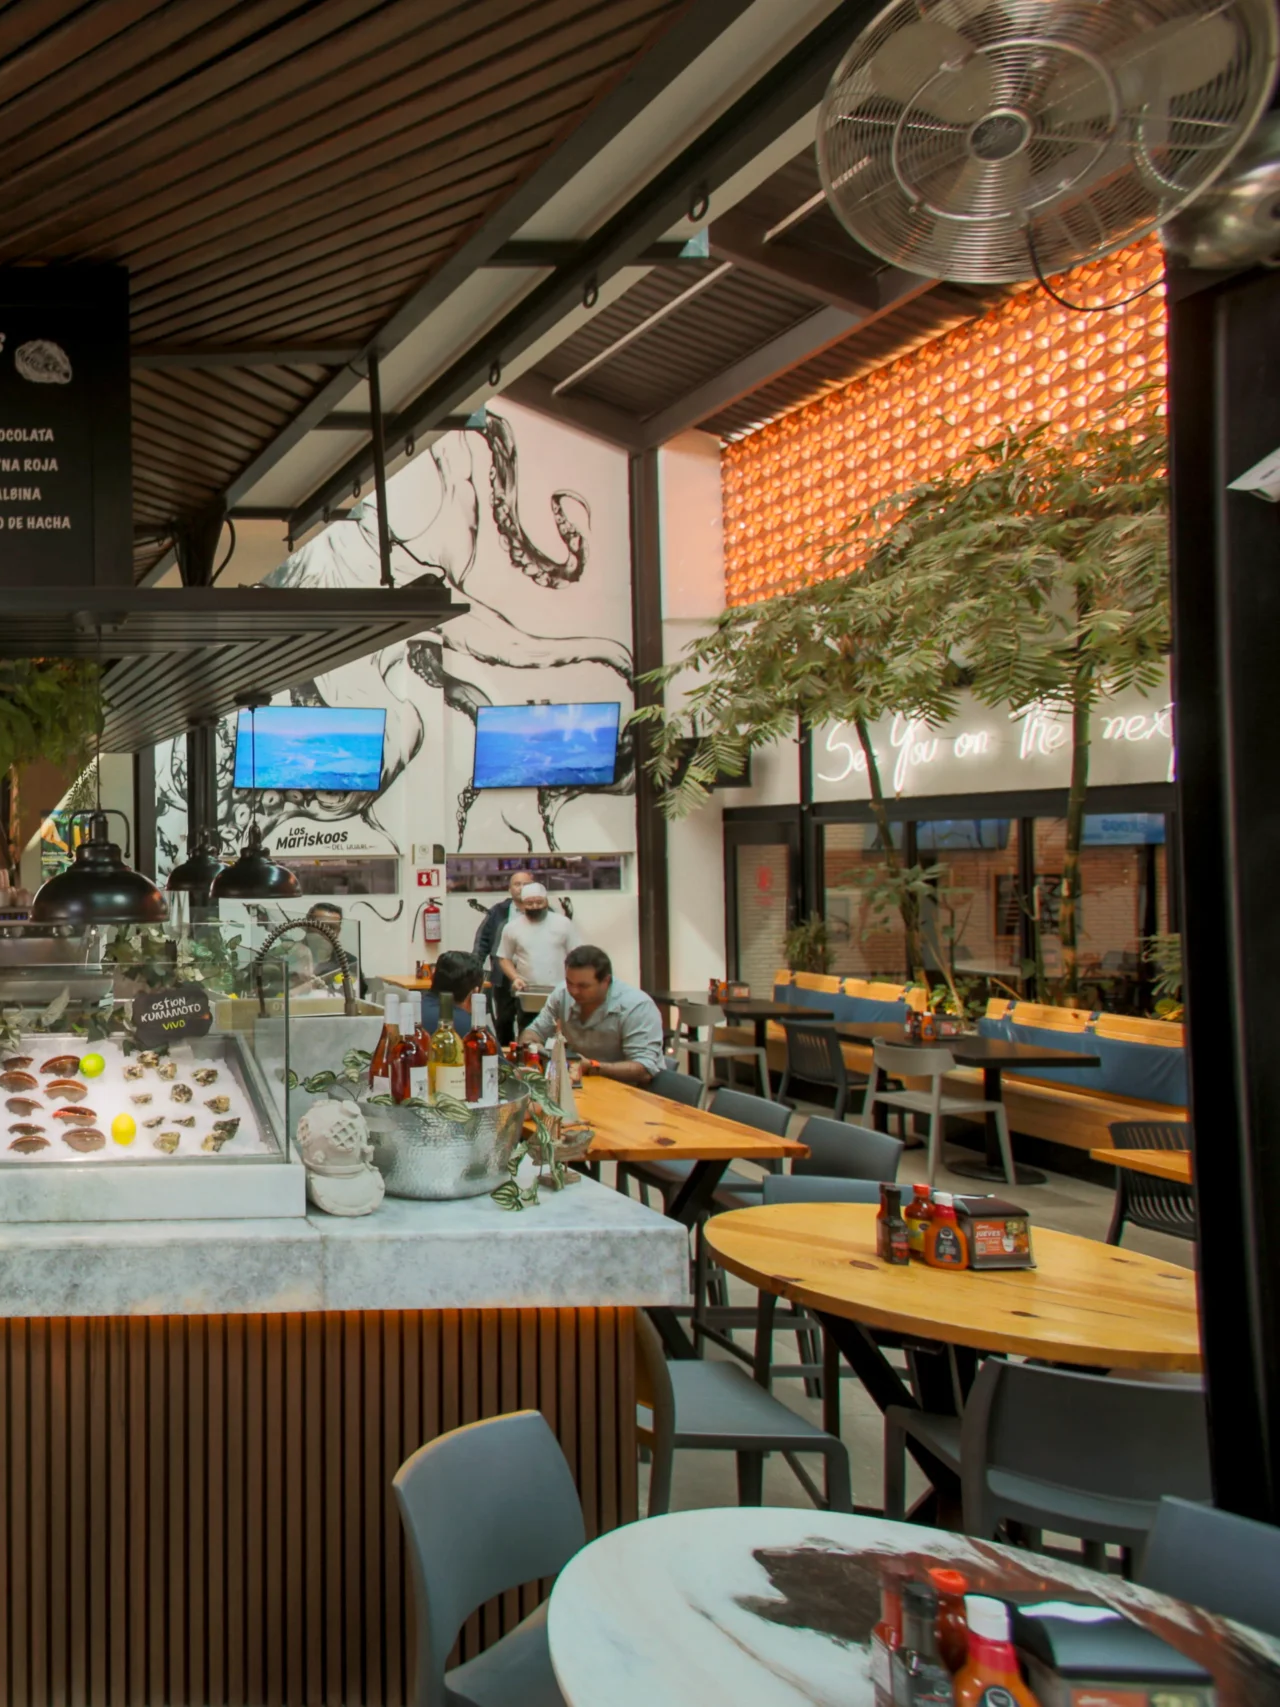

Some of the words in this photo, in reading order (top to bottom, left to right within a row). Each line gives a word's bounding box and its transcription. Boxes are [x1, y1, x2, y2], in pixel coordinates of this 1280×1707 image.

[24, 458, 58, 472] ROJA
[8, 517, 23, 529] DE
[27, 517, 71, 529] HACHA
[954, 730, 989, 758] on
[276, 831, 348, 850] Mariskoos
[141, 1004, 201, 1022] KUMAMOTO
